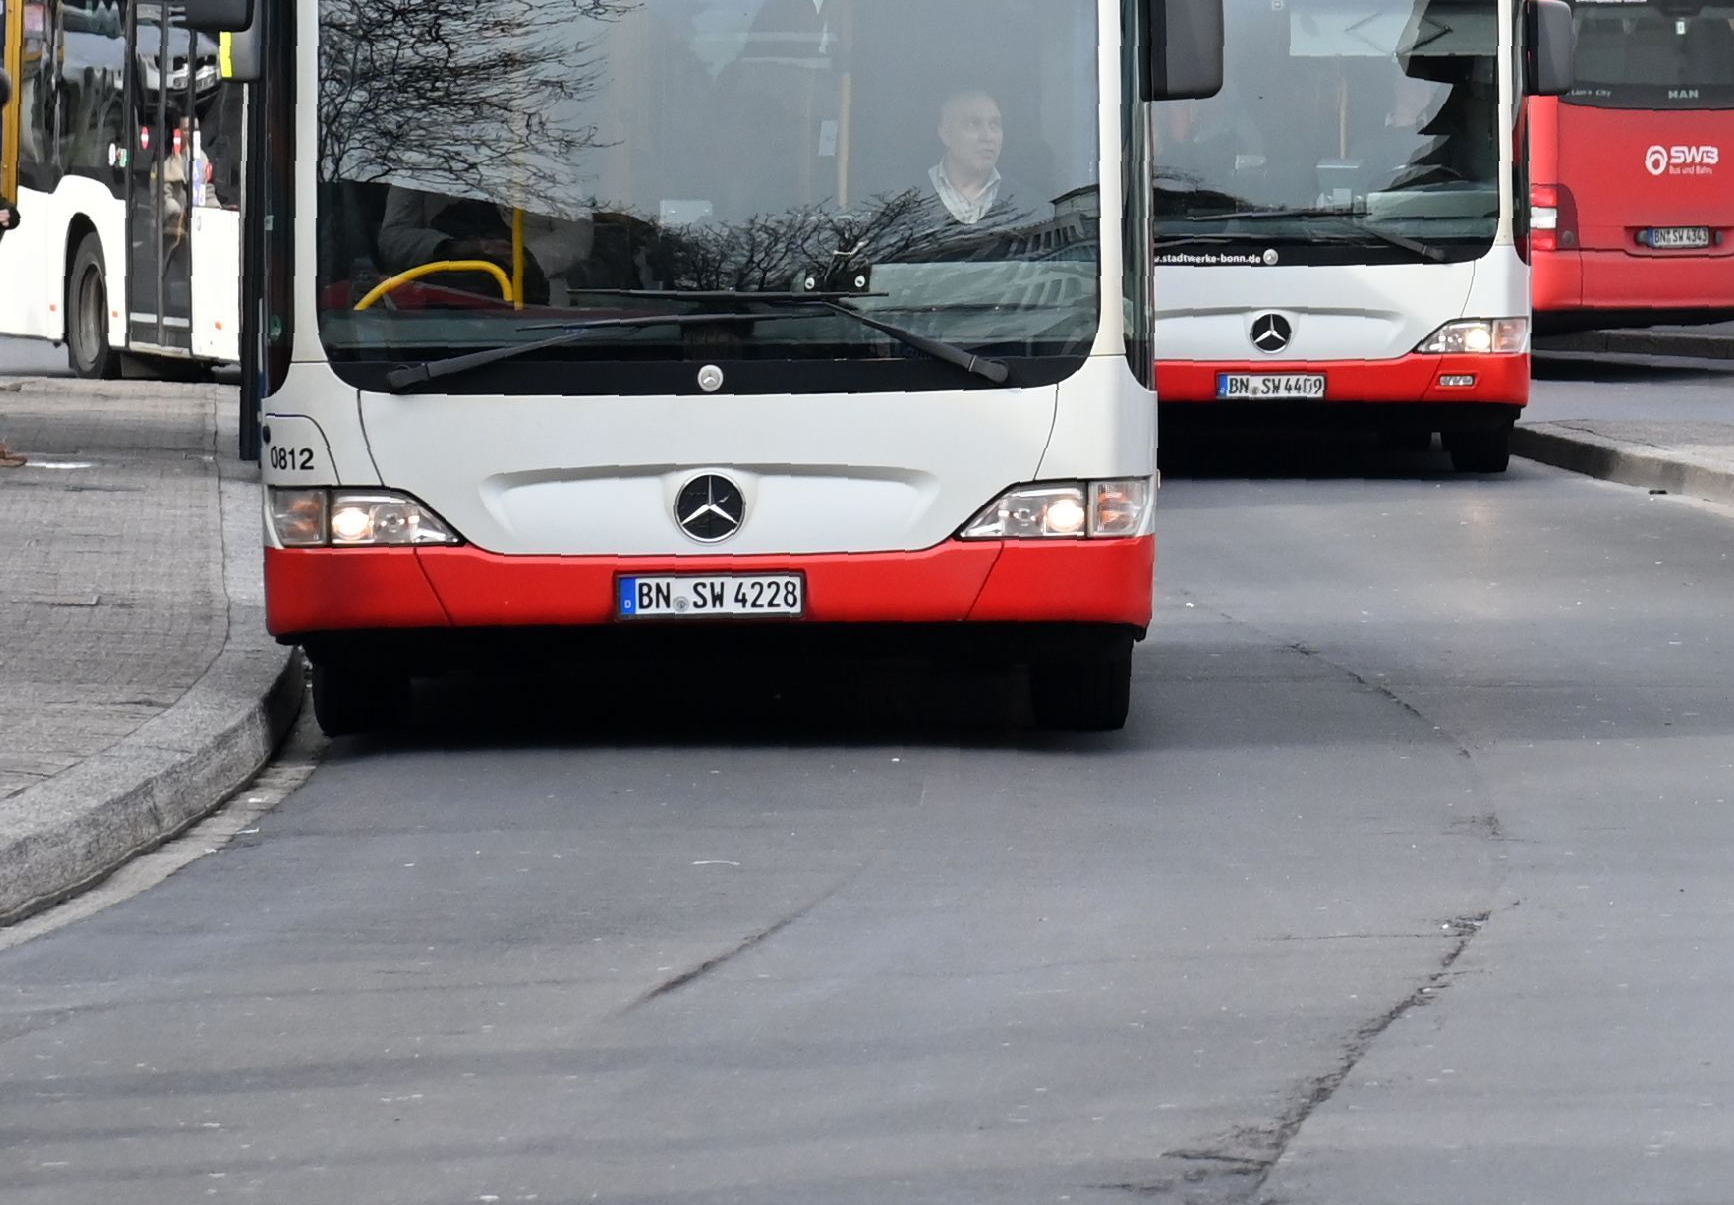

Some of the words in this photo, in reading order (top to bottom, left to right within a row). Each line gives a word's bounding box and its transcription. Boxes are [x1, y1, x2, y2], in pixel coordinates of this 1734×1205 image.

[1667, 89, 1699, 100] MAN
[1669, 146, 1720, 165] SWB
[1229, 377, 1250, 395] BN
[1260, 377, 1282, 395] SW
[270, 446, 315, 471] 0812
[638, 581, 671, 610] BN
[692, 581, 726, 608] SW
[733, 580, 798, 608] 4228
